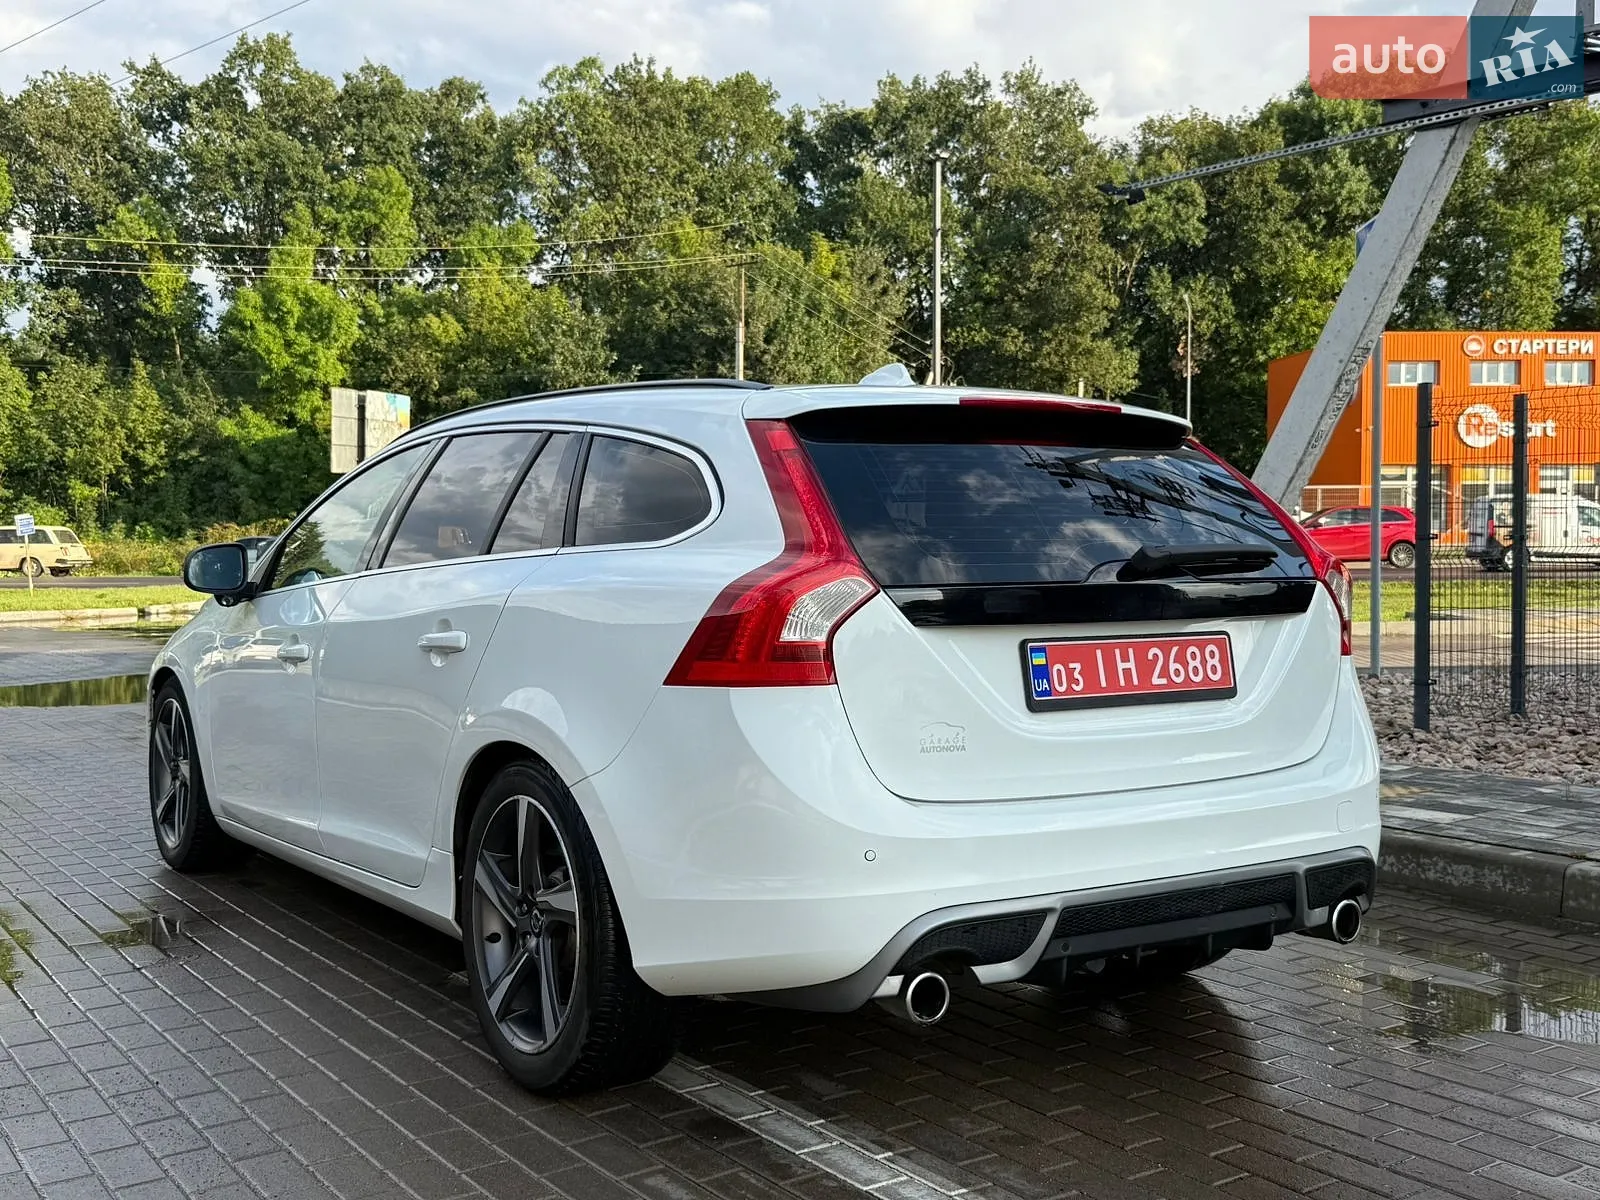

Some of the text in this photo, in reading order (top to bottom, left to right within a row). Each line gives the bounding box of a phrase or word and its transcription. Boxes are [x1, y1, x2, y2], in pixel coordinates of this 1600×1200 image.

[1493, 338, 1594, 355] СТАРТЕРИ
[1464, 412, 1556, 438] Resart
[1052, 662, 1084, 693] 03
[1147, 644, 1222, 685] 2688
[1035, 678, 1050, 692] UA
[919, 733, 967, 746] GARAGE
[919, 744, 967, 754] AUTONOVA
